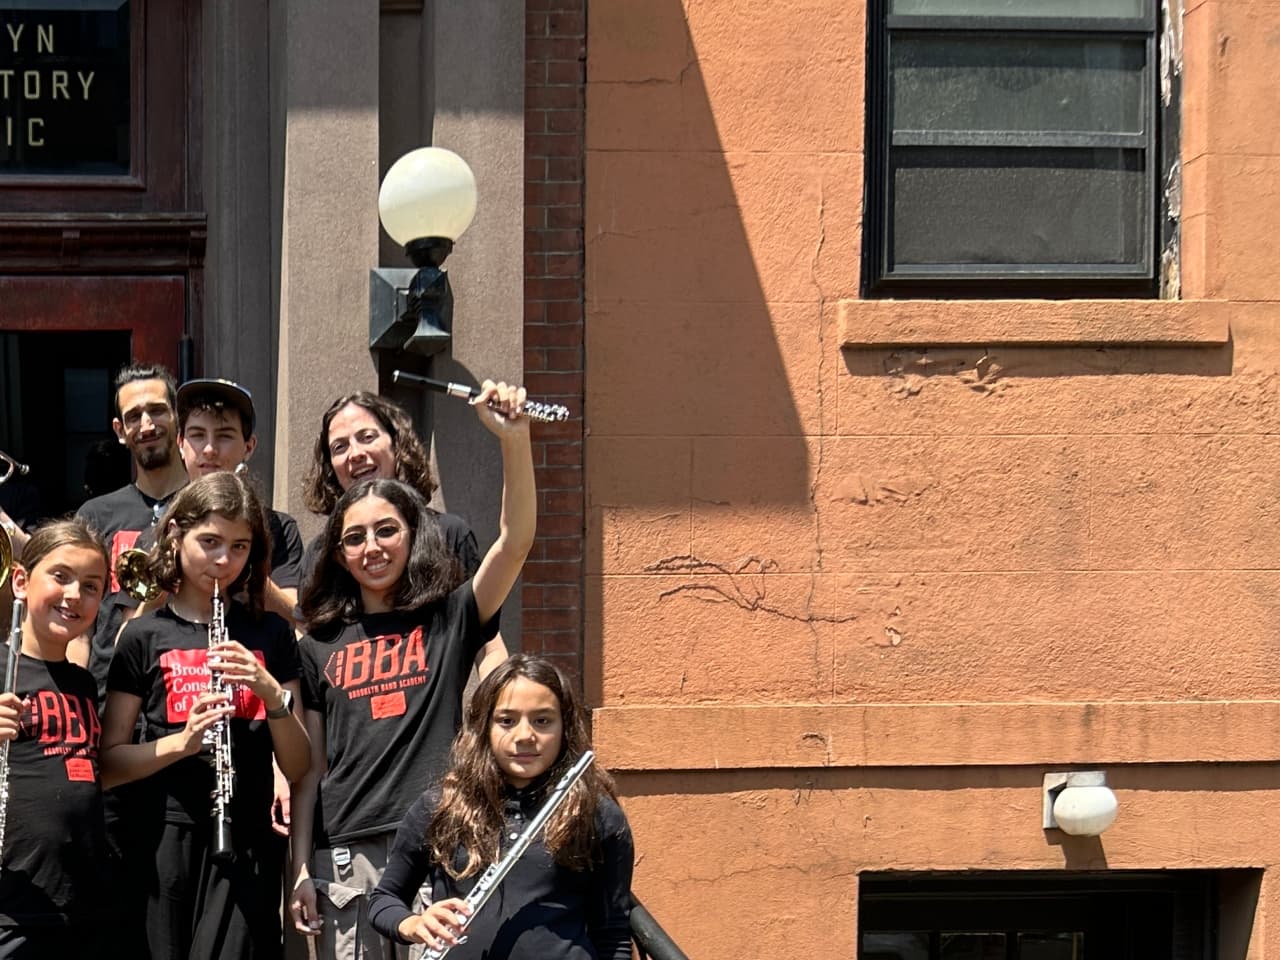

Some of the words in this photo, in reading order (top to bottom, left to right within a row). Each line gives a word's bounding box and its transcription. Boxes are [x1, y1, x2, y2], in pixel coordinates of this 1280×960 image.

[171, 661, 210, 677] Brook
[342, 625, 429, 690] BBA
[38, 690, 102, 747] BBA
[174, 695, 187, 712] of
